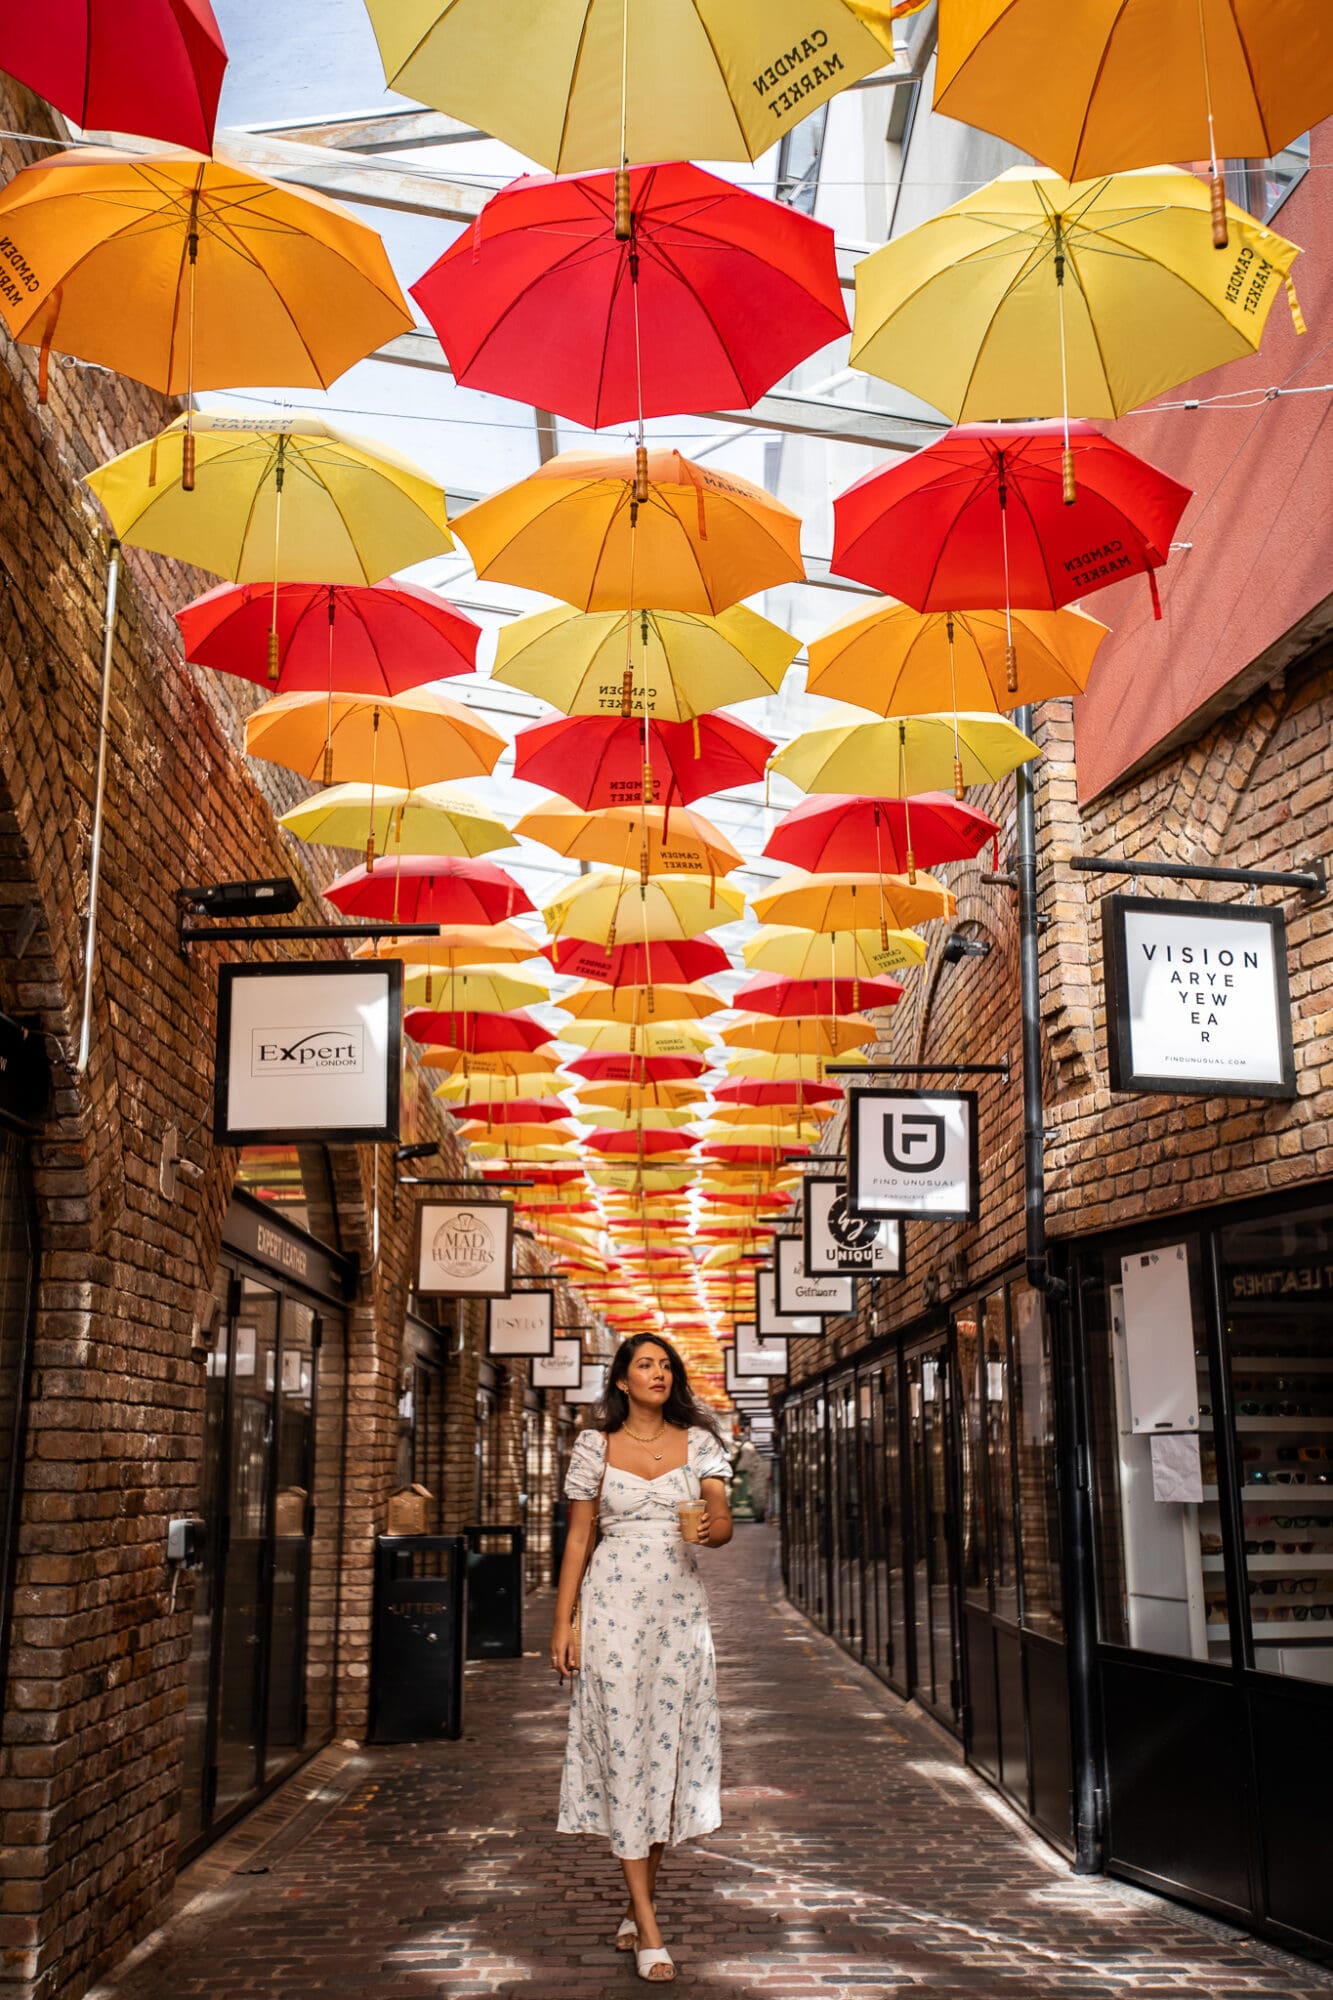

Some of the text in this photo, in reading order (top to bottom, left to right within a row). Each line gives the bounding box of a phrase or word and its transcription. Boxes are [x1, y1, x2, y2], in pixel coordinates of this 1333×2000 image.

[1142, 943, 1258, 969] VISION
[1170, 970, 1234, 987] ARYE
[1179, 991, 1227, 1006] YEW
[1191, 1012, 1218, 1026] EA
[1201, 1031, 1210, 1043] R
[259, 1038, 355, 1065] Expert
[315, 1059, 357, 1067] LONDON
[872, 1178, 955, 1187] FIND UNUSUAL
[446, 1232, 485, 1248] MAD
[432, 1249, 495, 1263] HATTERS
[826, 1248, 884, 1263] UNIQUE
